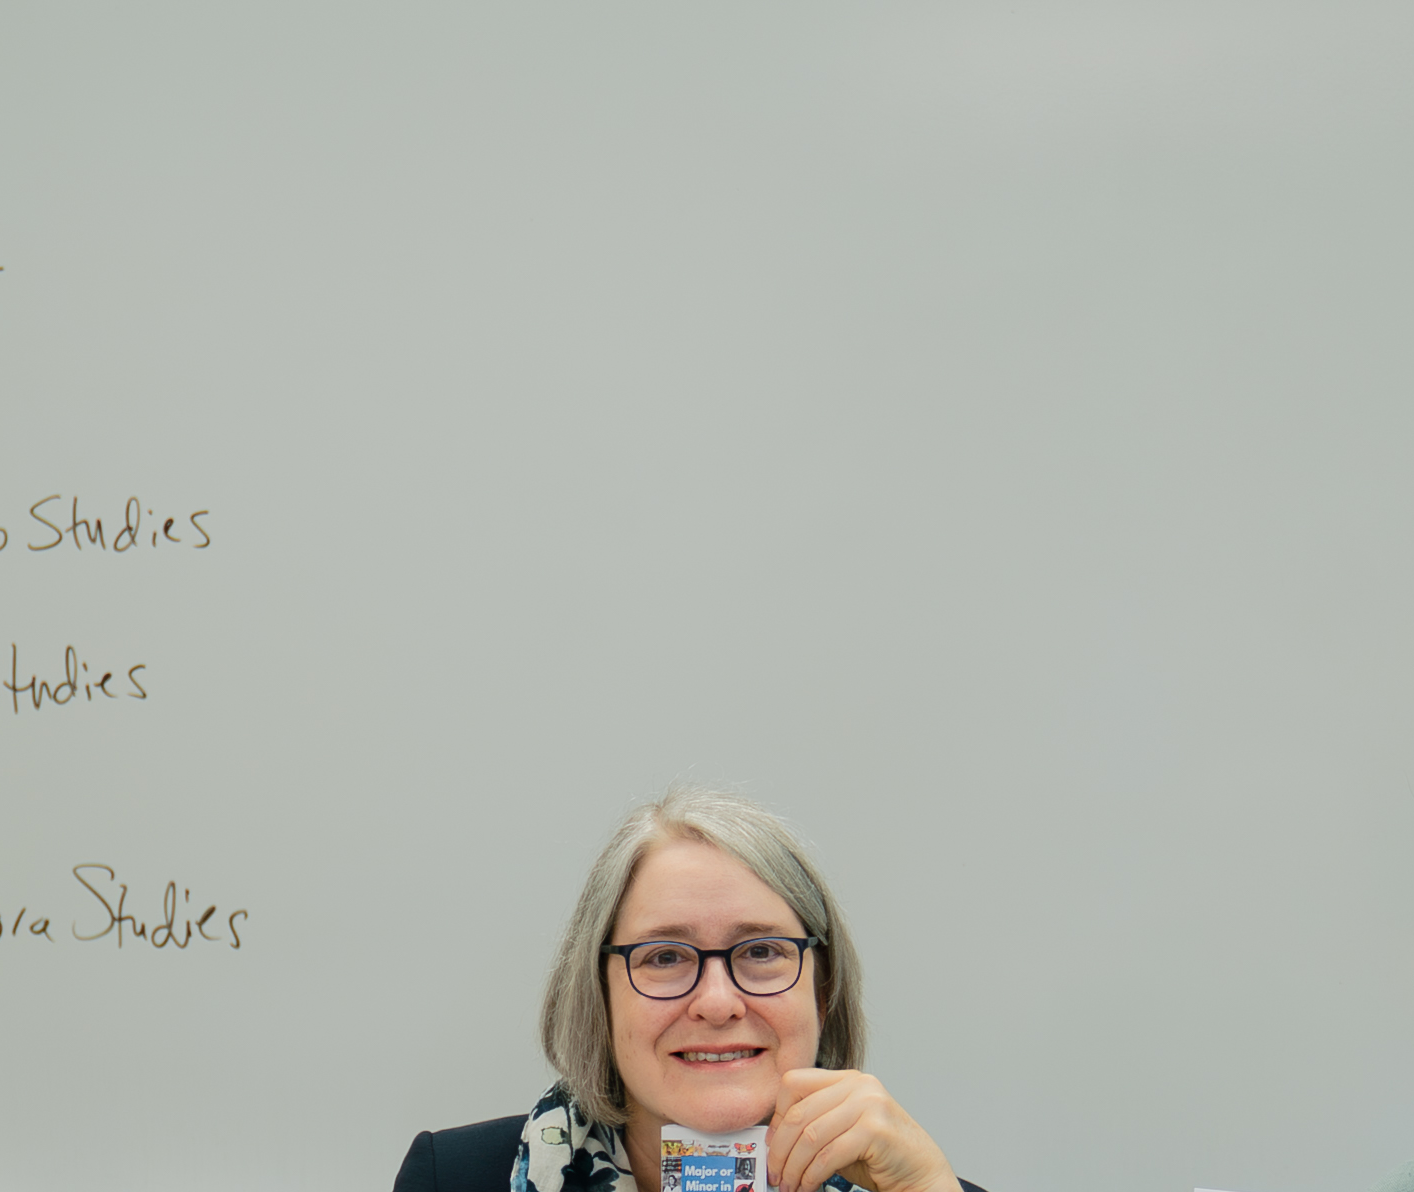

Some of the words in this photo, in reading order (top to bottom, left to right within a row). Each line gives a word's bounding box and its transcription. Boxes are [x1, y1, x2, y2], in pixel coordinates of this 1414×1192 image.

[27, 495, 211, 553] Studies
[70, 863, 248, 950] Studies
[684, 1165, 718, 1179] Major
[720, 1168, 733, 1177] or
[685, 1181, 718, 1192] Minor
[721, 1181, 732, 1192] in
